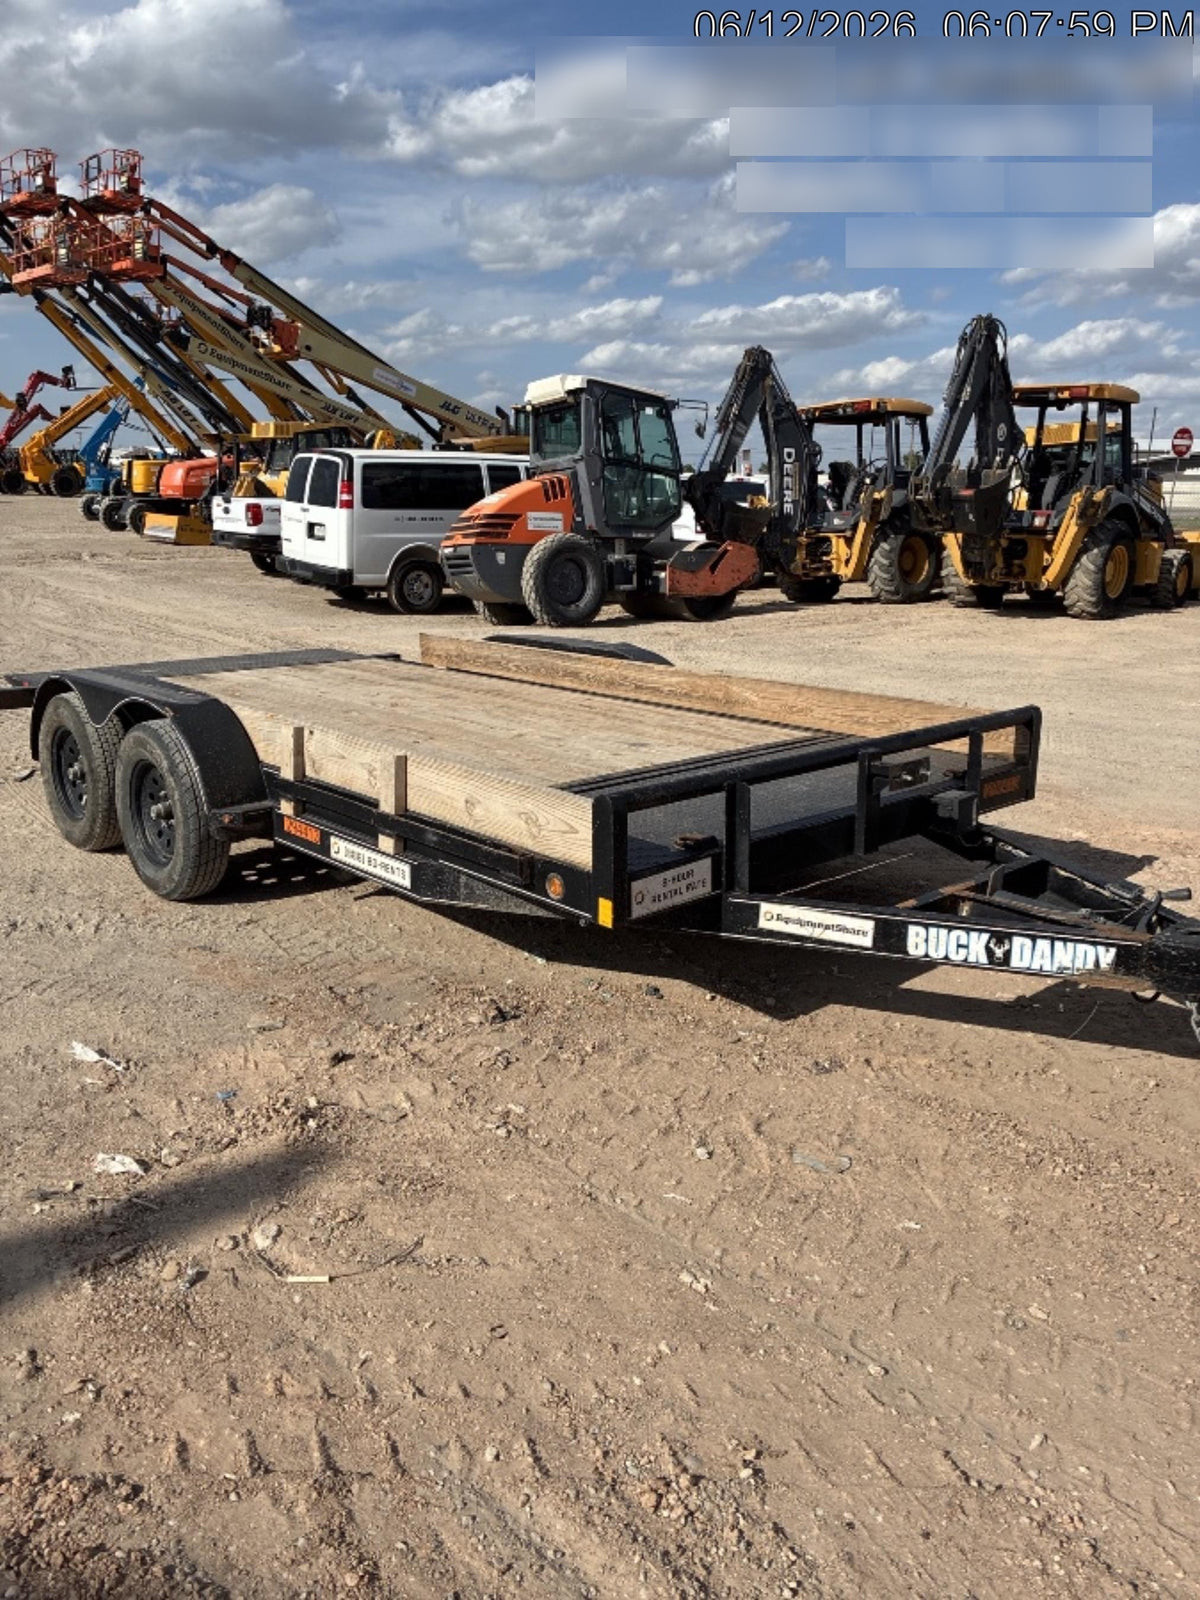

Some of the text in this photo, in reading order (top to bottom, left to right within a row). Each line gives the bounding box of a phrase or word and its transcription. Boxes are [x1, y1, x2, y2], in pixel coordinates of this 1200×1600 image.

[208, 347, 292, 392] EquipmentShare
[783, 447, 796, 516] DEERE
[906, 924, 1118, 975] BUCK DANDY
